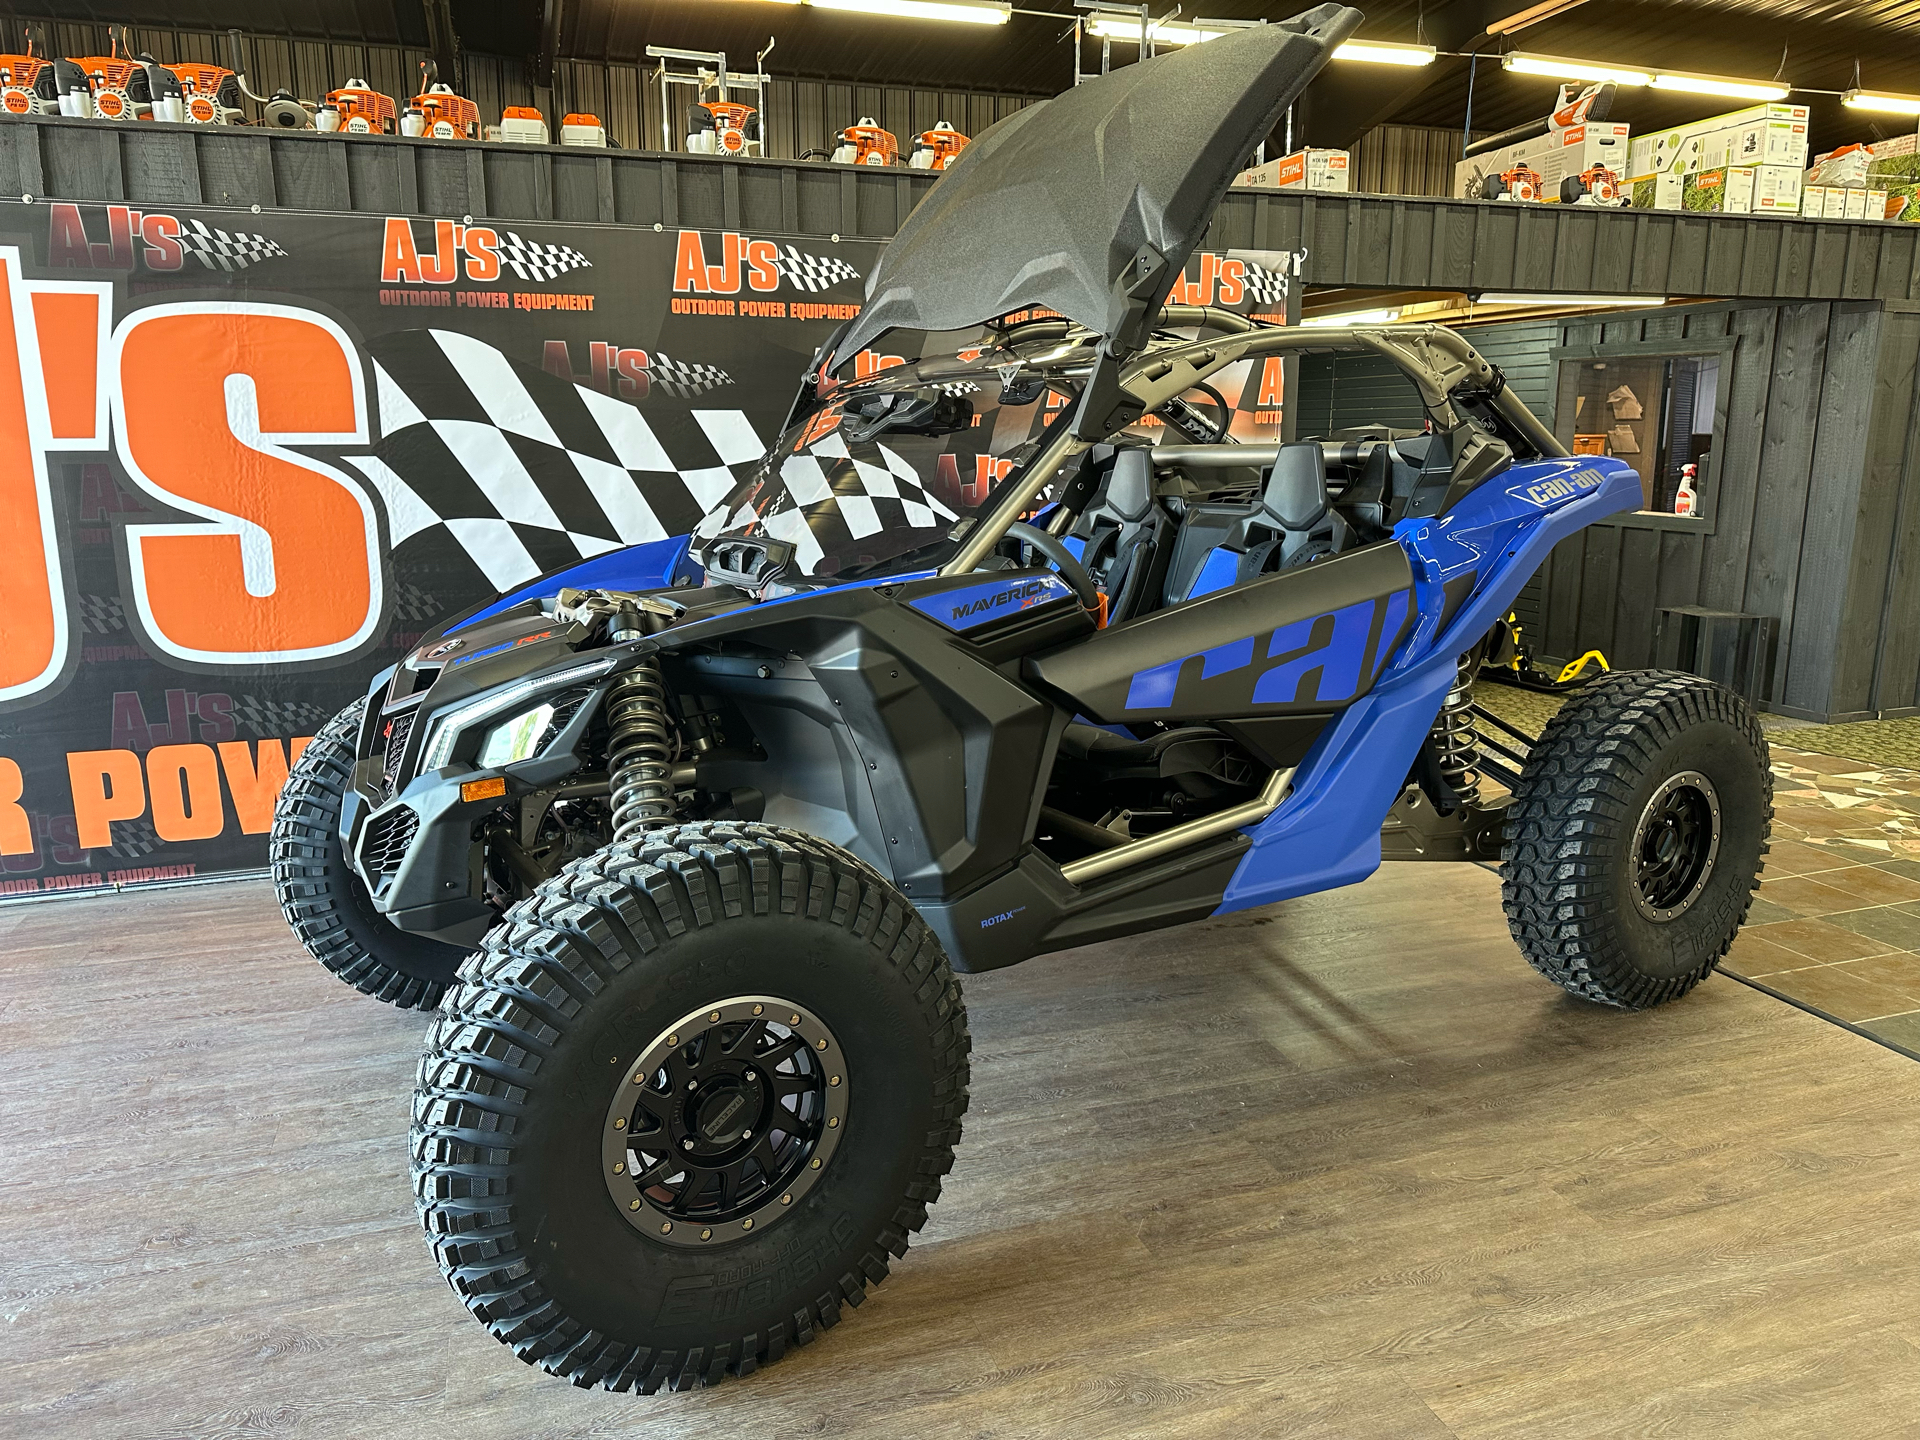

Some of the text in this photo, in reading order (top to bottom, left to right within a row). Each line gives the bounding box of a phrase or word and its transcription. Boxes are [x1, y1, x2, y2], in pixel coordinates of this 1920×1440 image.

[1565, 130, 1583, 142] STIHL
[1281, 162, 1303, 179] STIHL
[1330, 158, 1346, 166] STIHL
[1699, 175, 1720, 186] STIHL
[48, 203, 184, 272] AJ'S
[380, 217, 501, 284] AJ'S
[673, 230, 780, 294] AJ'S
[379, 289, 595, 312] OUTDOOR POWER EQUIPMENT
[671, 298, 862, 321] OUTDOOR POWER EQUIPMENT
[542, 340, 650, 400] AJ'S
[1526, 468, 1606, 504] can-am
[951, 579, 1053, 621] MAVERICK
[453, 631, 552, 666] TURBO RR
[110, 688, 237, 750] AJ'S
[43, 872, 103, 891] POWER
[107, 863, 197, 884] EQUIPMENT
[980, 910, 1014, 929] ROTAX
[707, 1095, 745, 1136] RACELINE
